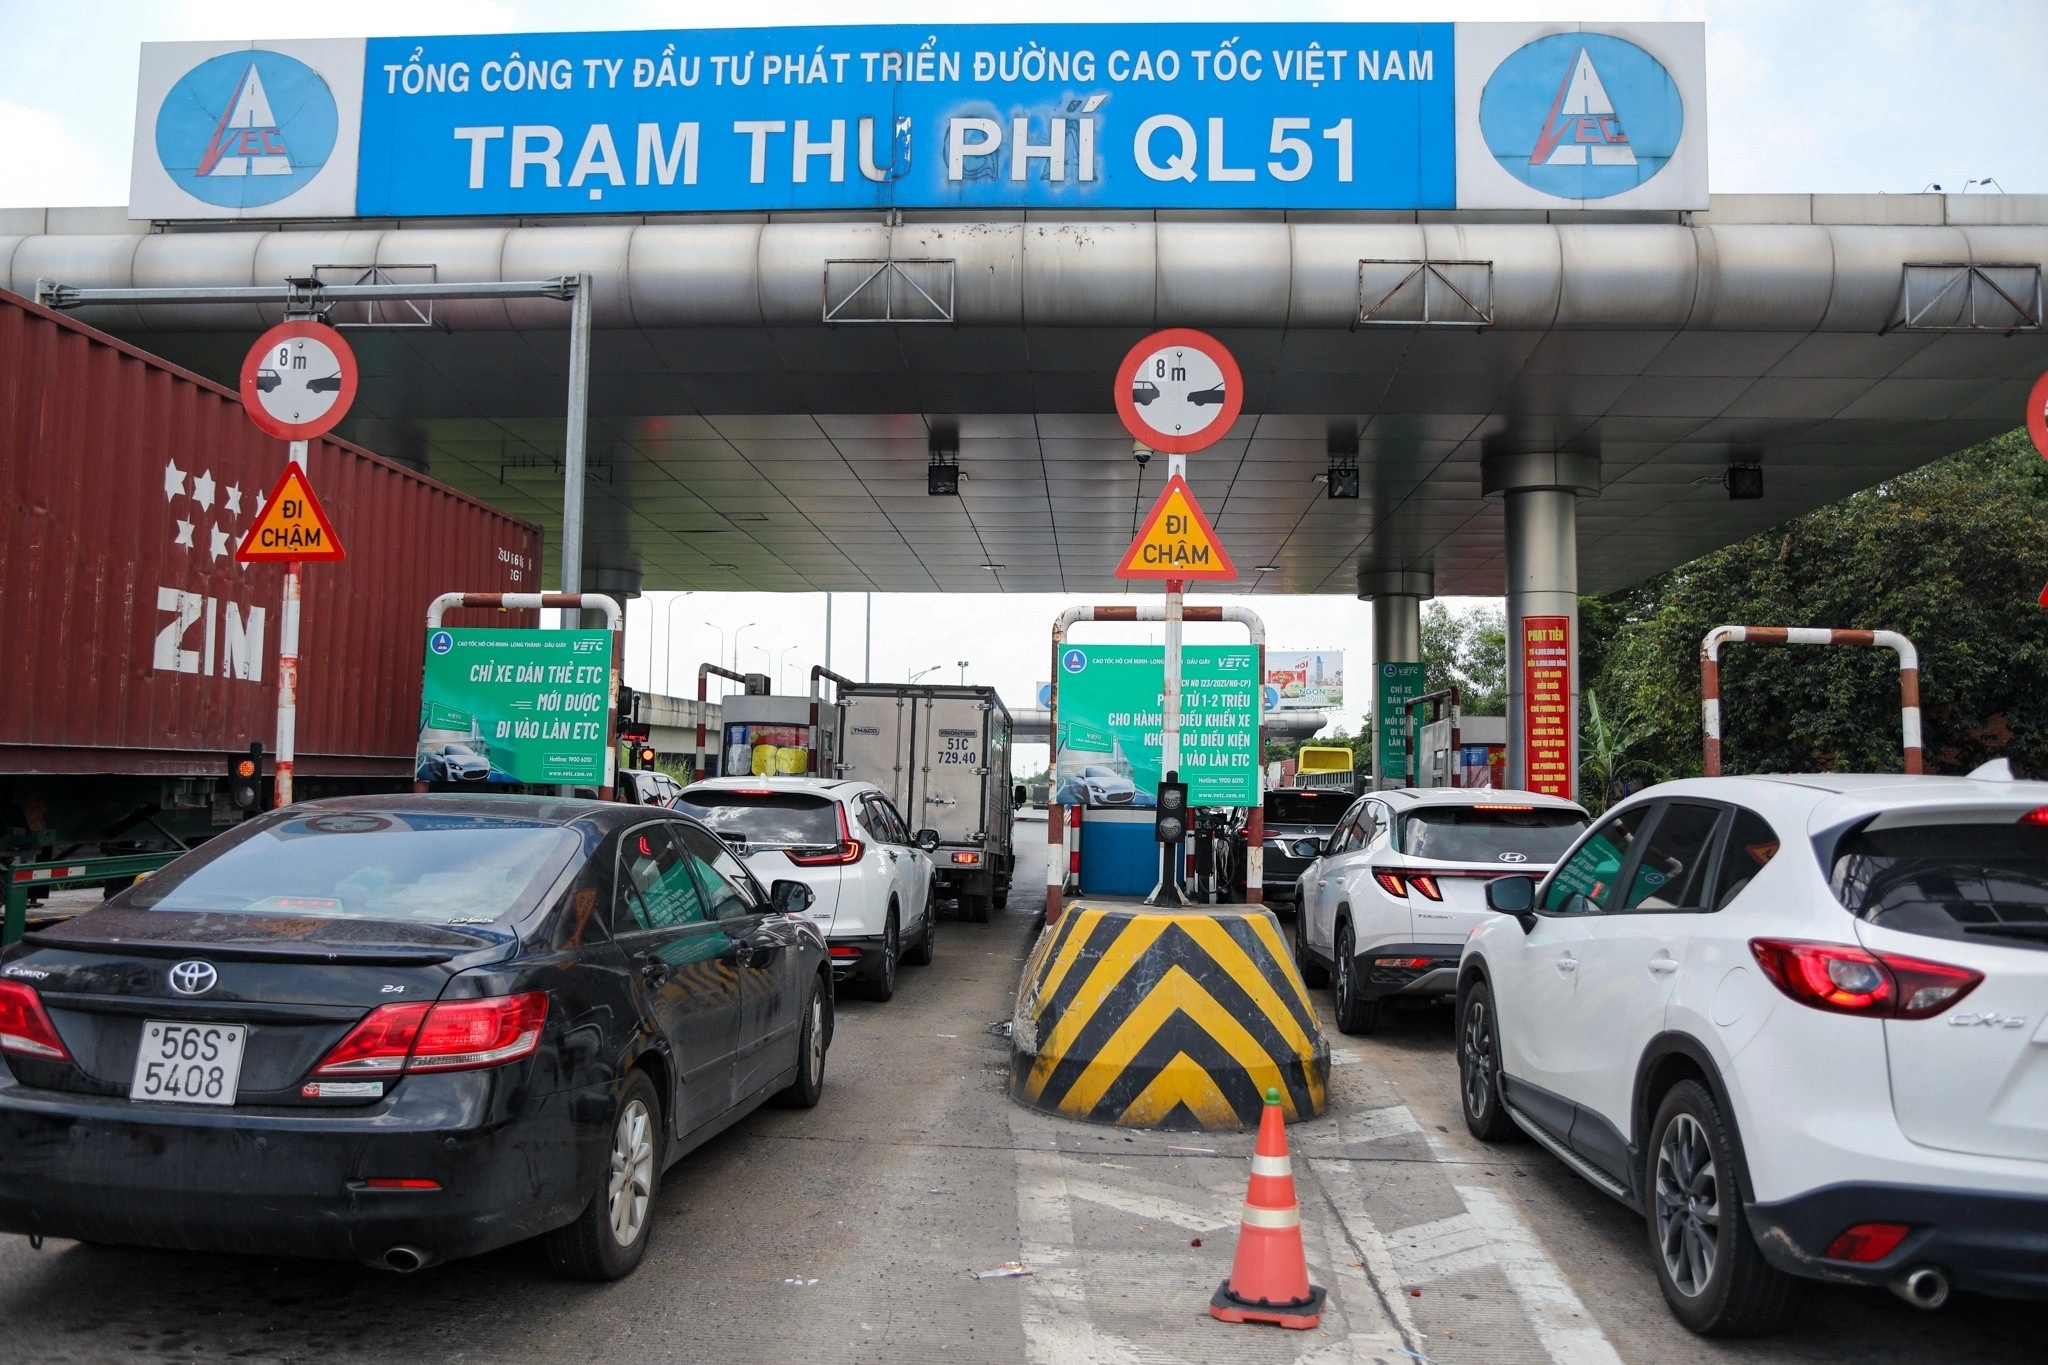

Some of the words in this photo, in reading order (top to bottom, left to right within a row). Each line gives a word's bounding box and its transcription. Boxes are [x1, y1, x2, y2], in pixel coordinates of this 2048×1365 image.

[384, 46, 470, 94] TỔNG
[481, 52, 572, 91] CÔNG
[583, 59, 623, 89] TY
[633, 43, 700, 88] ĐẦU
[710, 51, 754, 86] TƯ
[763, 45, 850, 85] PHÁT
[860, 36, 960, 82] TRIỂN
[973, 42, 1095, 82] ĐƯỜNG
[1108, 50, 1180, 82] CAO
[1191, 37, 1262, 81] TỐC
[1272, 49, 1347, 87] VIỆT
[1358, 50, 1434, 81] NAM
[454, 122, 700, 200] TRẠM
[733, 116, 912, 184] THU
[948, 94, 1108, 183] PHÍ
[280, 348, 288, 366] 8
[293, 355, 306, 370] m
[1156, 359, 1166, 378] 8
[1172, 367, 1186, 382] m
[282, 500, 302, 518] ĐI
[1166, 515, 1188, 534] ĐI
[261, 523, 321, 551] CHẬM
[1143, 540, 1208, 569] CHẬM
[153, 586, 266, 682] ZIN
[1528, 630, 1547, 643] PHẠT
[1548, 626, 1564, 641] TIỀN
[573, 642, 603, 651] VETC
[470, 660, 494, 682] CHỈ
[495, 665, 513, 683] XE
[516, 662, 543, 683] DÁN
[548, 661, 574, 684] THẺ
[576, 666, 602, 684] ETC
[1218, 658, 1250, 668] VETC
[1391, 684, 1402, 693] CHỈ
[537, 690, 561, 711] MỚI
[565, 694, 601, 716] ĐƯỢC
[1186, 690, 1200, 707] TỪ
[1202, 694, 1218, 707] 1-2
[1221, 691, 1251, 710] TRIỆU
[1108, 713, 1130, 726] CHO
[1134, 710, 1162, 726] HÀNH
[1206, 709, 1235, 726] KHIỂN
[1238, 714, 1251, 727] XE
[496, 720, 510, 738] ĐI
[514, 717, 539, 738] VÀO
[542, 718, 571, 739] LÀN
[573, 722, 599, 740] ETC
[948, 738, 968, 750] 51C
[1183, 730, 1198, 746] ĐỦ
[1200, 729, 1224, 746] ĐIỀU
[1228, 731, 1250, 750] KIỆN
[1388, 737, 1401, 746] LÀN
[938, 752, 976, 764] 729.40
[1187, 750, 1206, 766] VÀO
[1210, 750, 1228, 766] LÀN
[1232, 754, 1250, 766] ETC
[1948, 1013, 2027, 1028] CX-5
[160, 1028, 219, 1060] 56S
[144, 1062, 223, 1100] 5408
